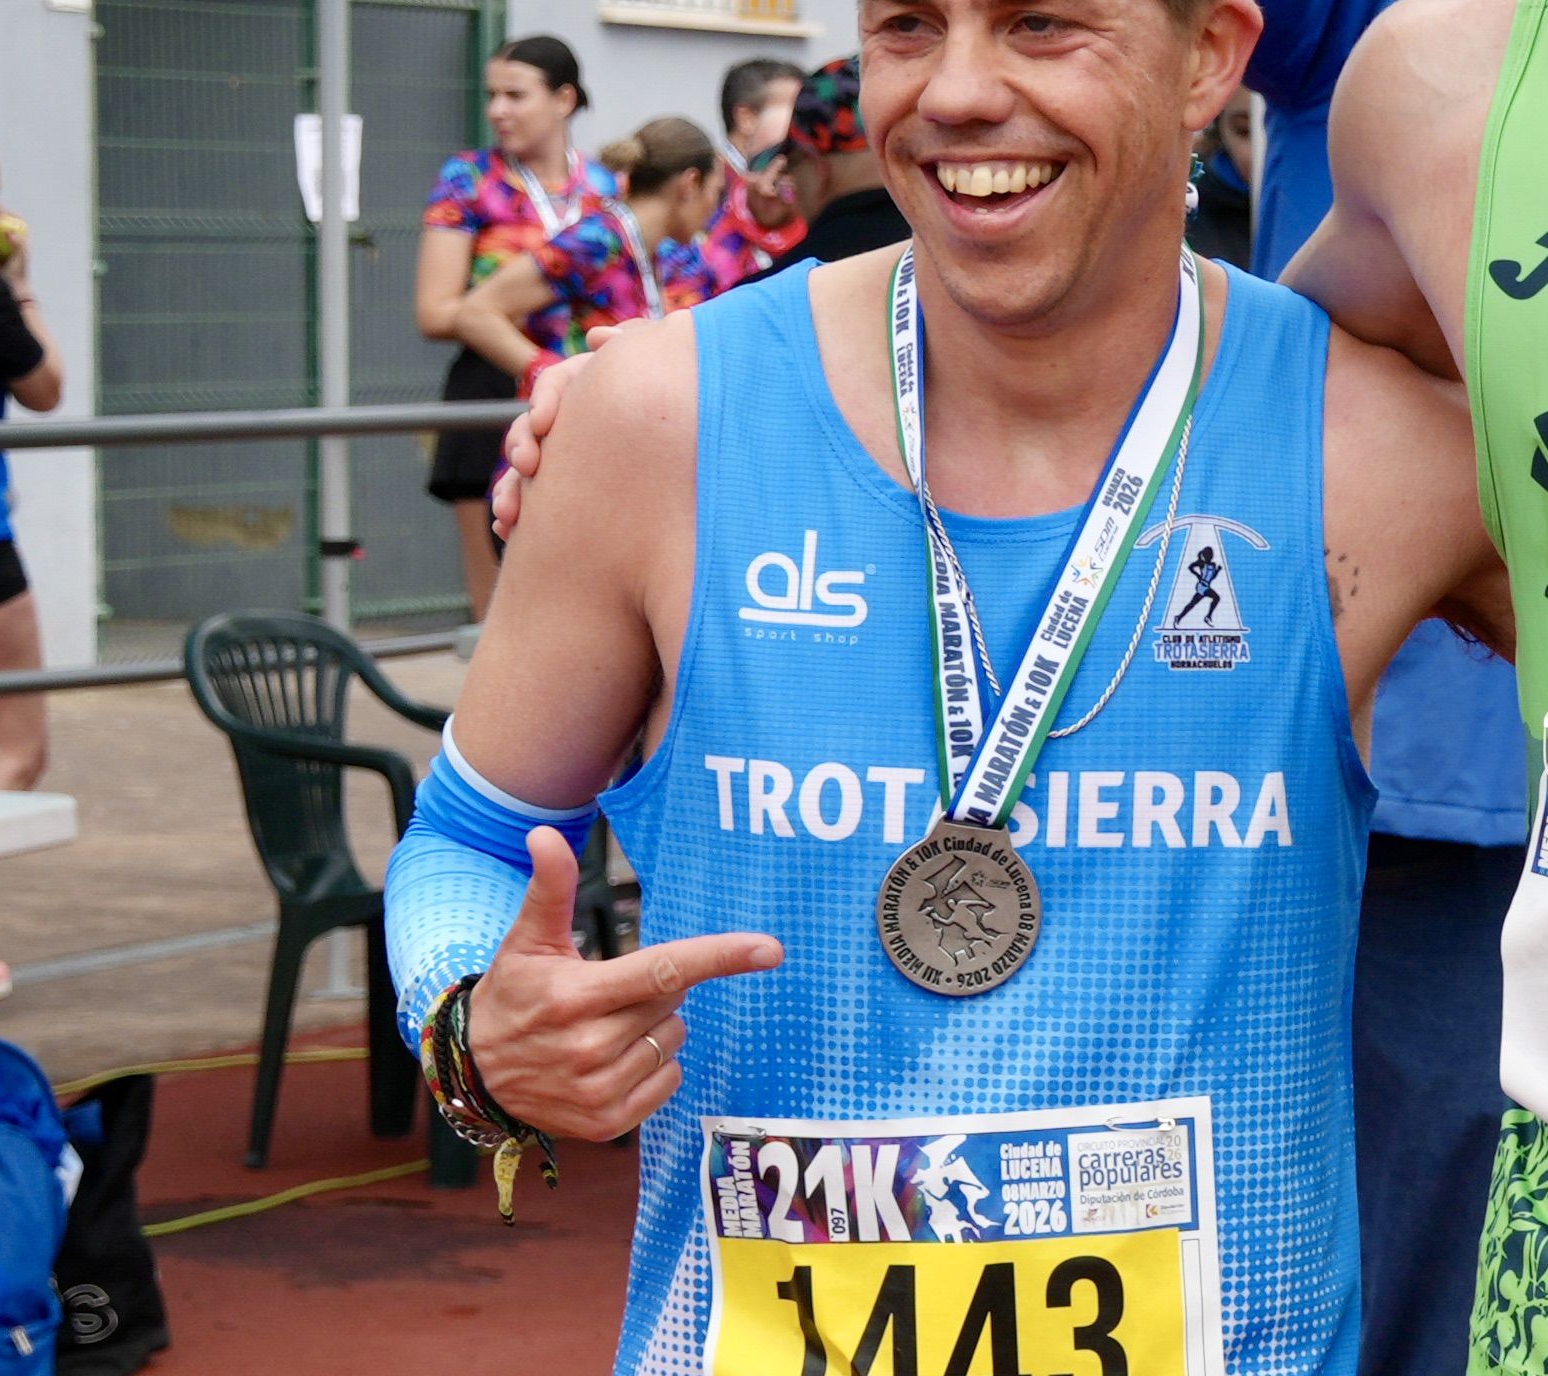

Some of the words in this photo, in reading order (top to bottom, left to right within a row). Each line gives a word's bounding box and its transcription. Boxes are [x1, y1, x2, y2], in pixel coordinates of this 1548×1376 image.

[1112, 473, 1144, 517] 2026
[743, 627, 798, 643] sport
[812, 630, 860, 646] shop
[1040, 605, 1065, 642] Ciudad
[1052, 595, 1090, 651] LUCENA
[938, 601, 974, 702] MARATÓN
[1154, 643, 1249, 660] TROTASIERRA
[1024, 653, 1060, 696] 10K
[947, 704, 965, 716] &
[1025, 694, 1043, 710] &
[949, 718, 974, 759] 10K
[974, 703, 1038, 807] MARATÓN
[704, 753, 1294, 850] TROTSIERRA
[904, 856, 920, 872] &
[915, 841, 942, 864] 10K
[943, 836, 994, 858] Ciudad
[991, 847, 1009, 867] de
[883, 867, 913, 934] MARATÓN
[1004, 860, 1032, 910] Lucena
[1018, 912, 1036, 932] 08
[888, 935, 925, 975] MEDIA
[991, 932, 1030, 976] MARZO
[956, 967, 993, 988] 2026
[1000, 1142, 1045, 1160] Ciudad
[1045, 1140, 1063, 1157] de
[1078, 1146, 1166, 1171] carreras
[1001, 1157, 1064, 1181] LUCENA
[1079, 1160, 1183, 1192] populares
[715, 1175, 743, 1237] MEDIA
[727, 1140, 764, 1239] MARATÓN
[757, 1140, 912, 1244] 21K
[1080, 1192, 1131, 1207] Diputación
[1133, 1190, 1146, 1202] de
[1147, 1185, 1185, 1199] Córdoba
[1003, 1199, 1068, 1236] 2026
